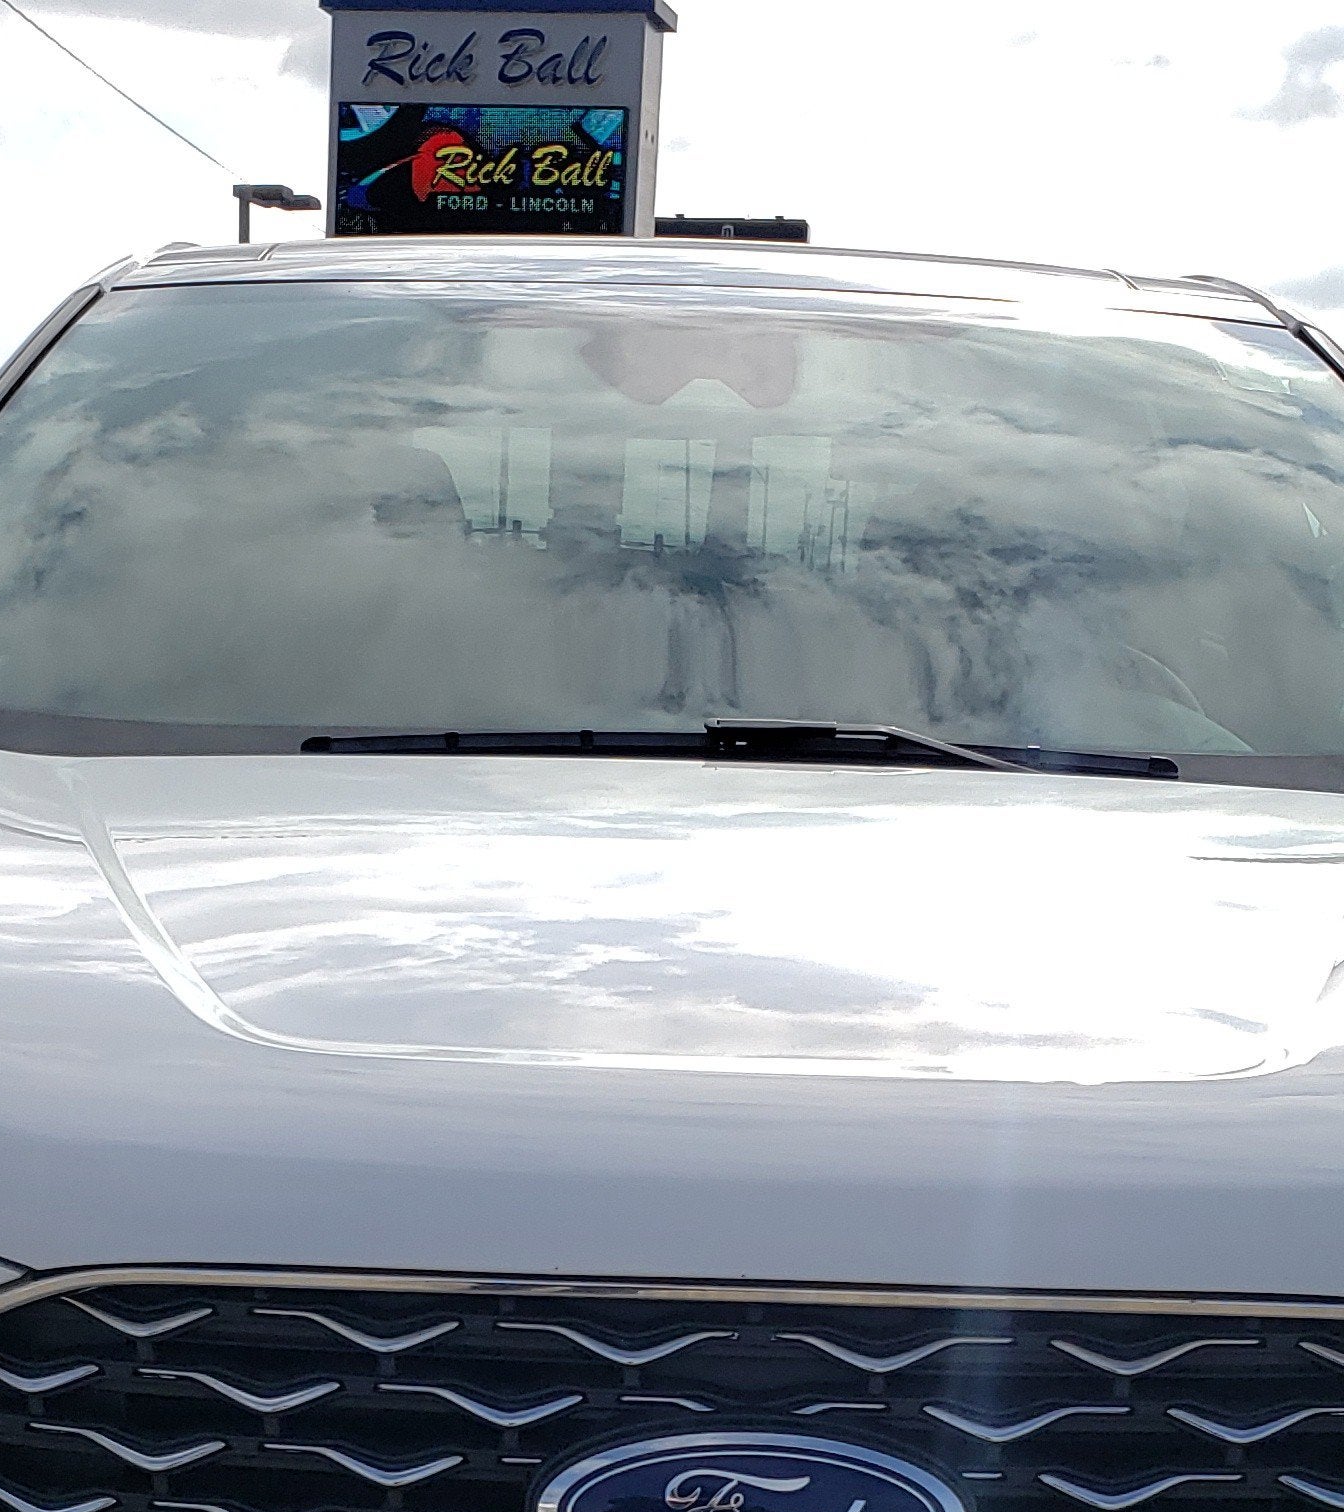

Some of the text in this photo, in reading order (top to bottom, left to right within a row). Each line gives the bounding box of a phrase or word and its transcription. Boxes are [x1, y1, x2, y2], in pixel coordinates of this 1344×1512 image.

[361, 28, 608, 87] Rick Ball
[432, 144, 613, 188] Rick Ball
[436, 195, 488, 211] FORD
[509, 197, 595, 213] LINCOLN
